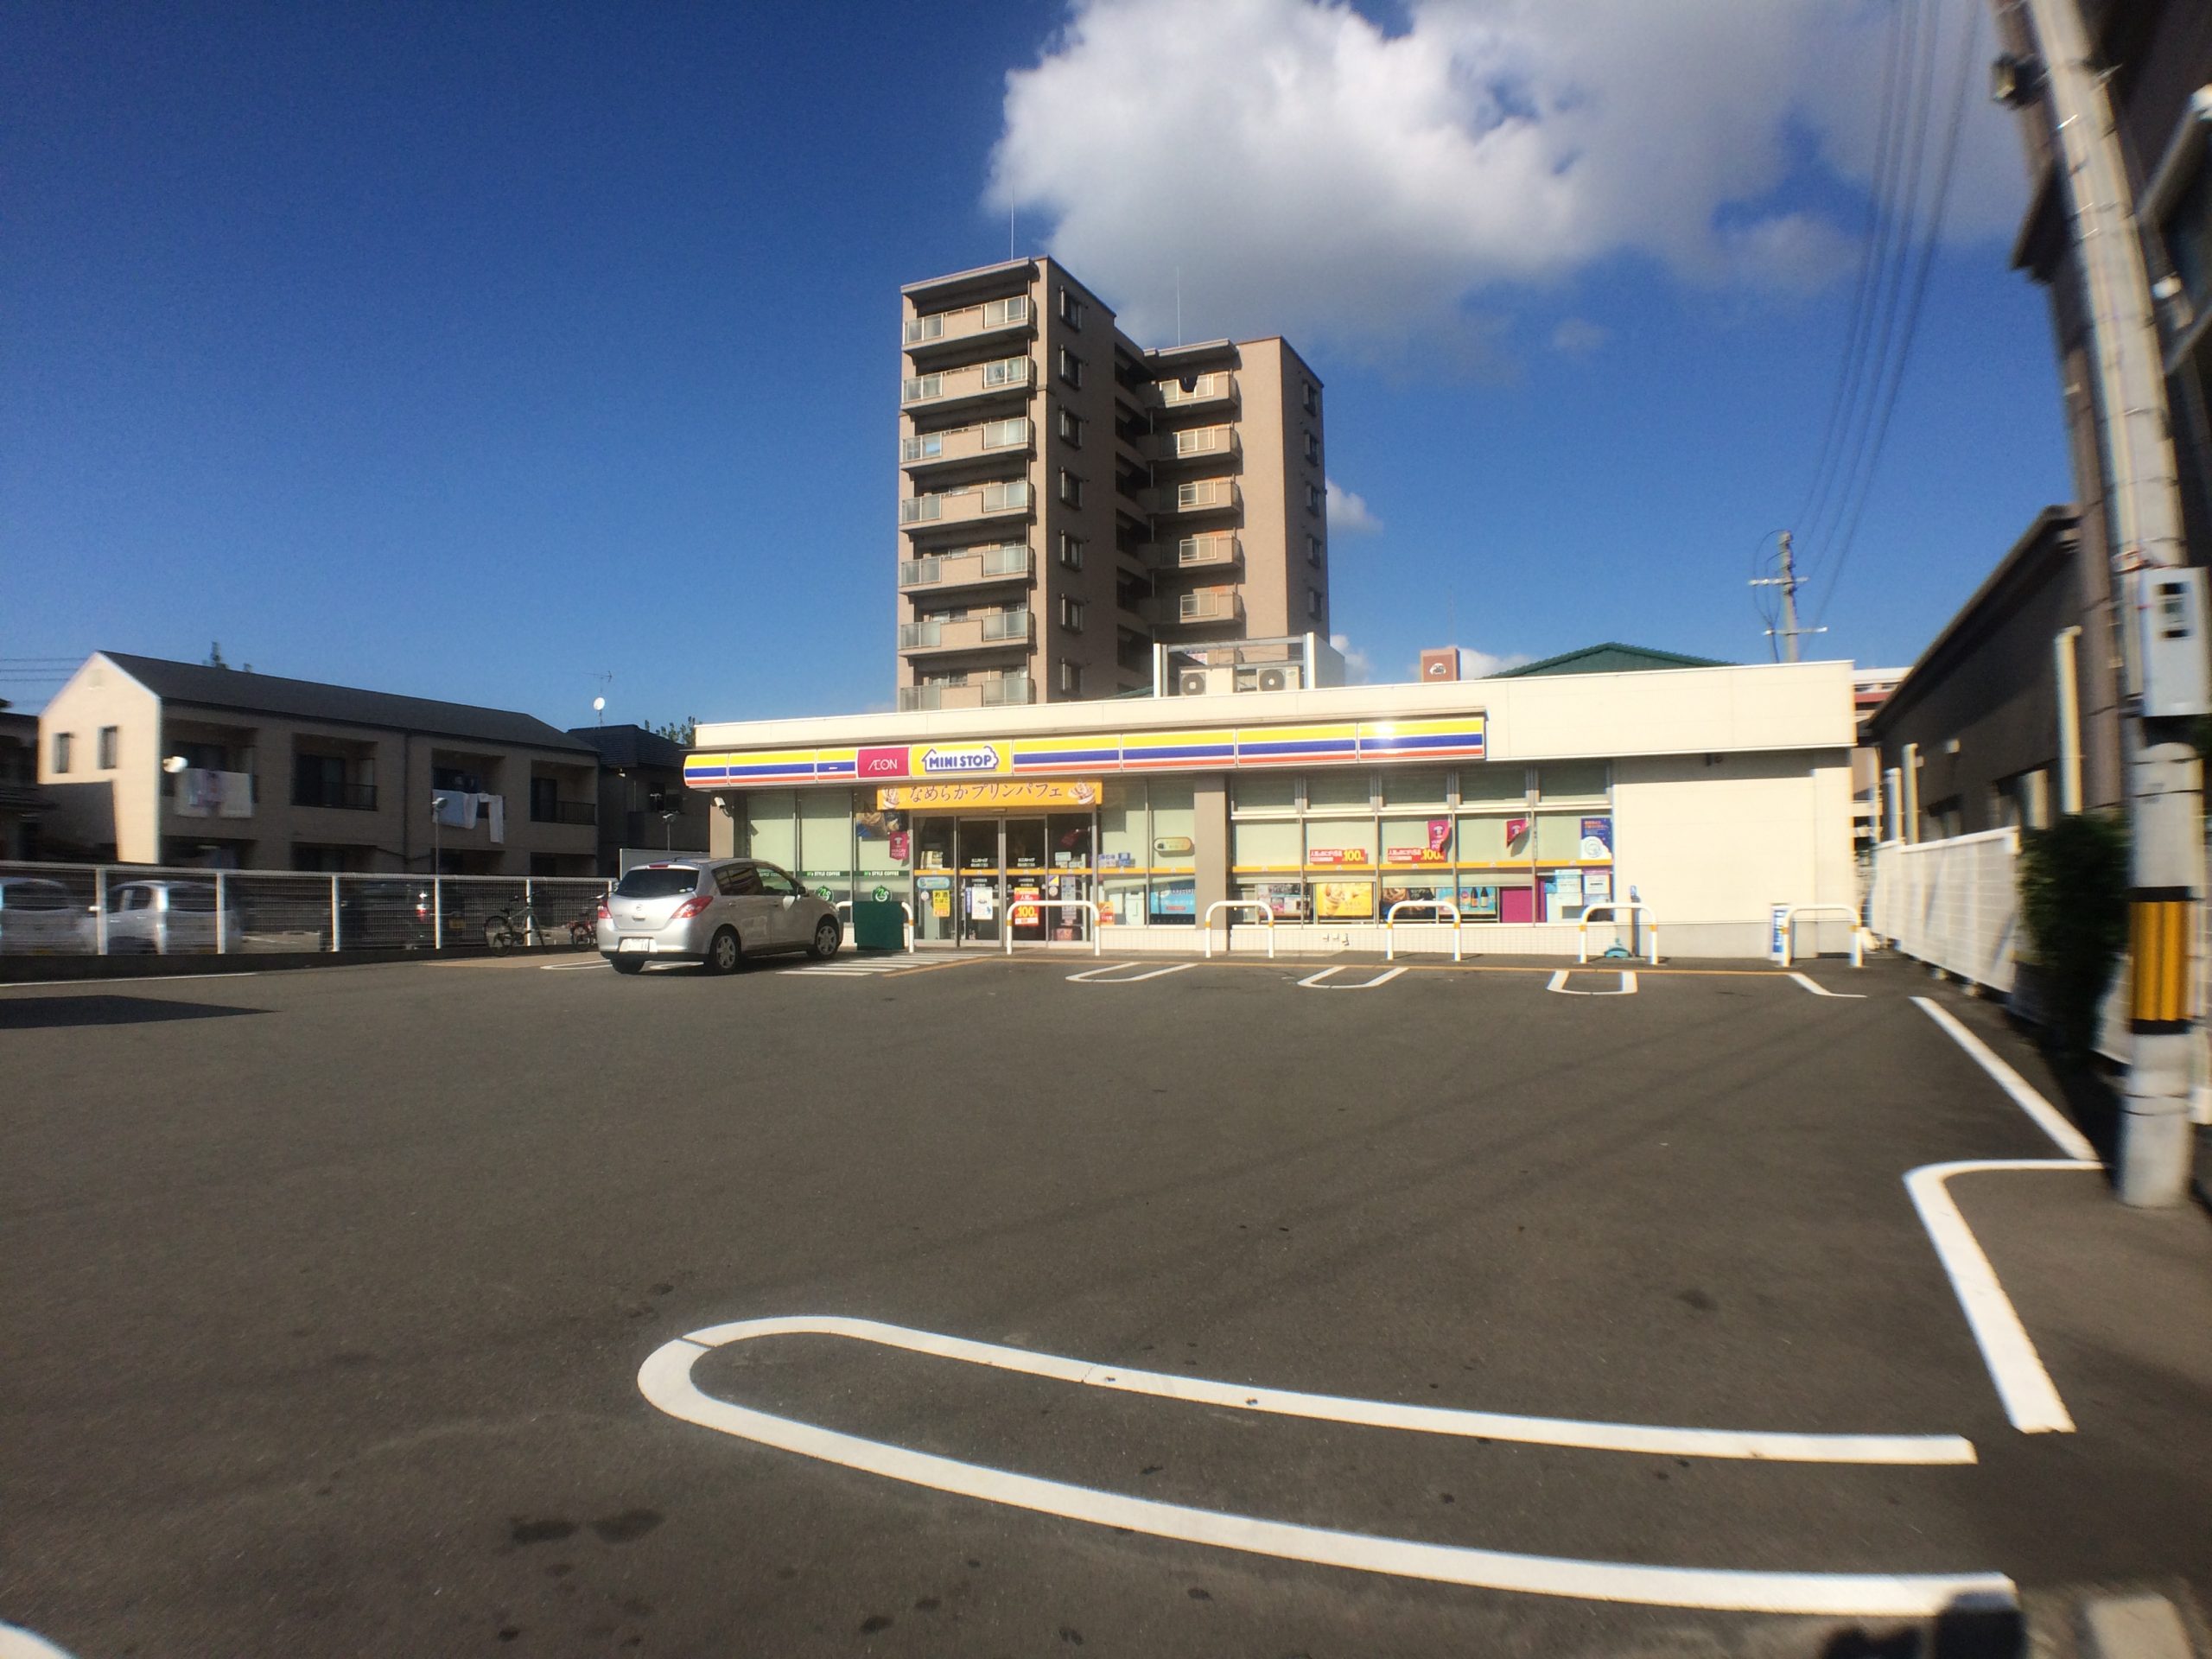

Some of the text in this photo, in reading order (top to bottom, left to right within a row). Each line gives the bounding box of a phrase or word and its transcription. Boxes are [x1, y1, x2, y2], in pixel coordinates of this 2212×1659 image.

[929, 754, 992, 768] MINI STOP
[910, 782, 1062, 803] なめらかプリンパフェ
